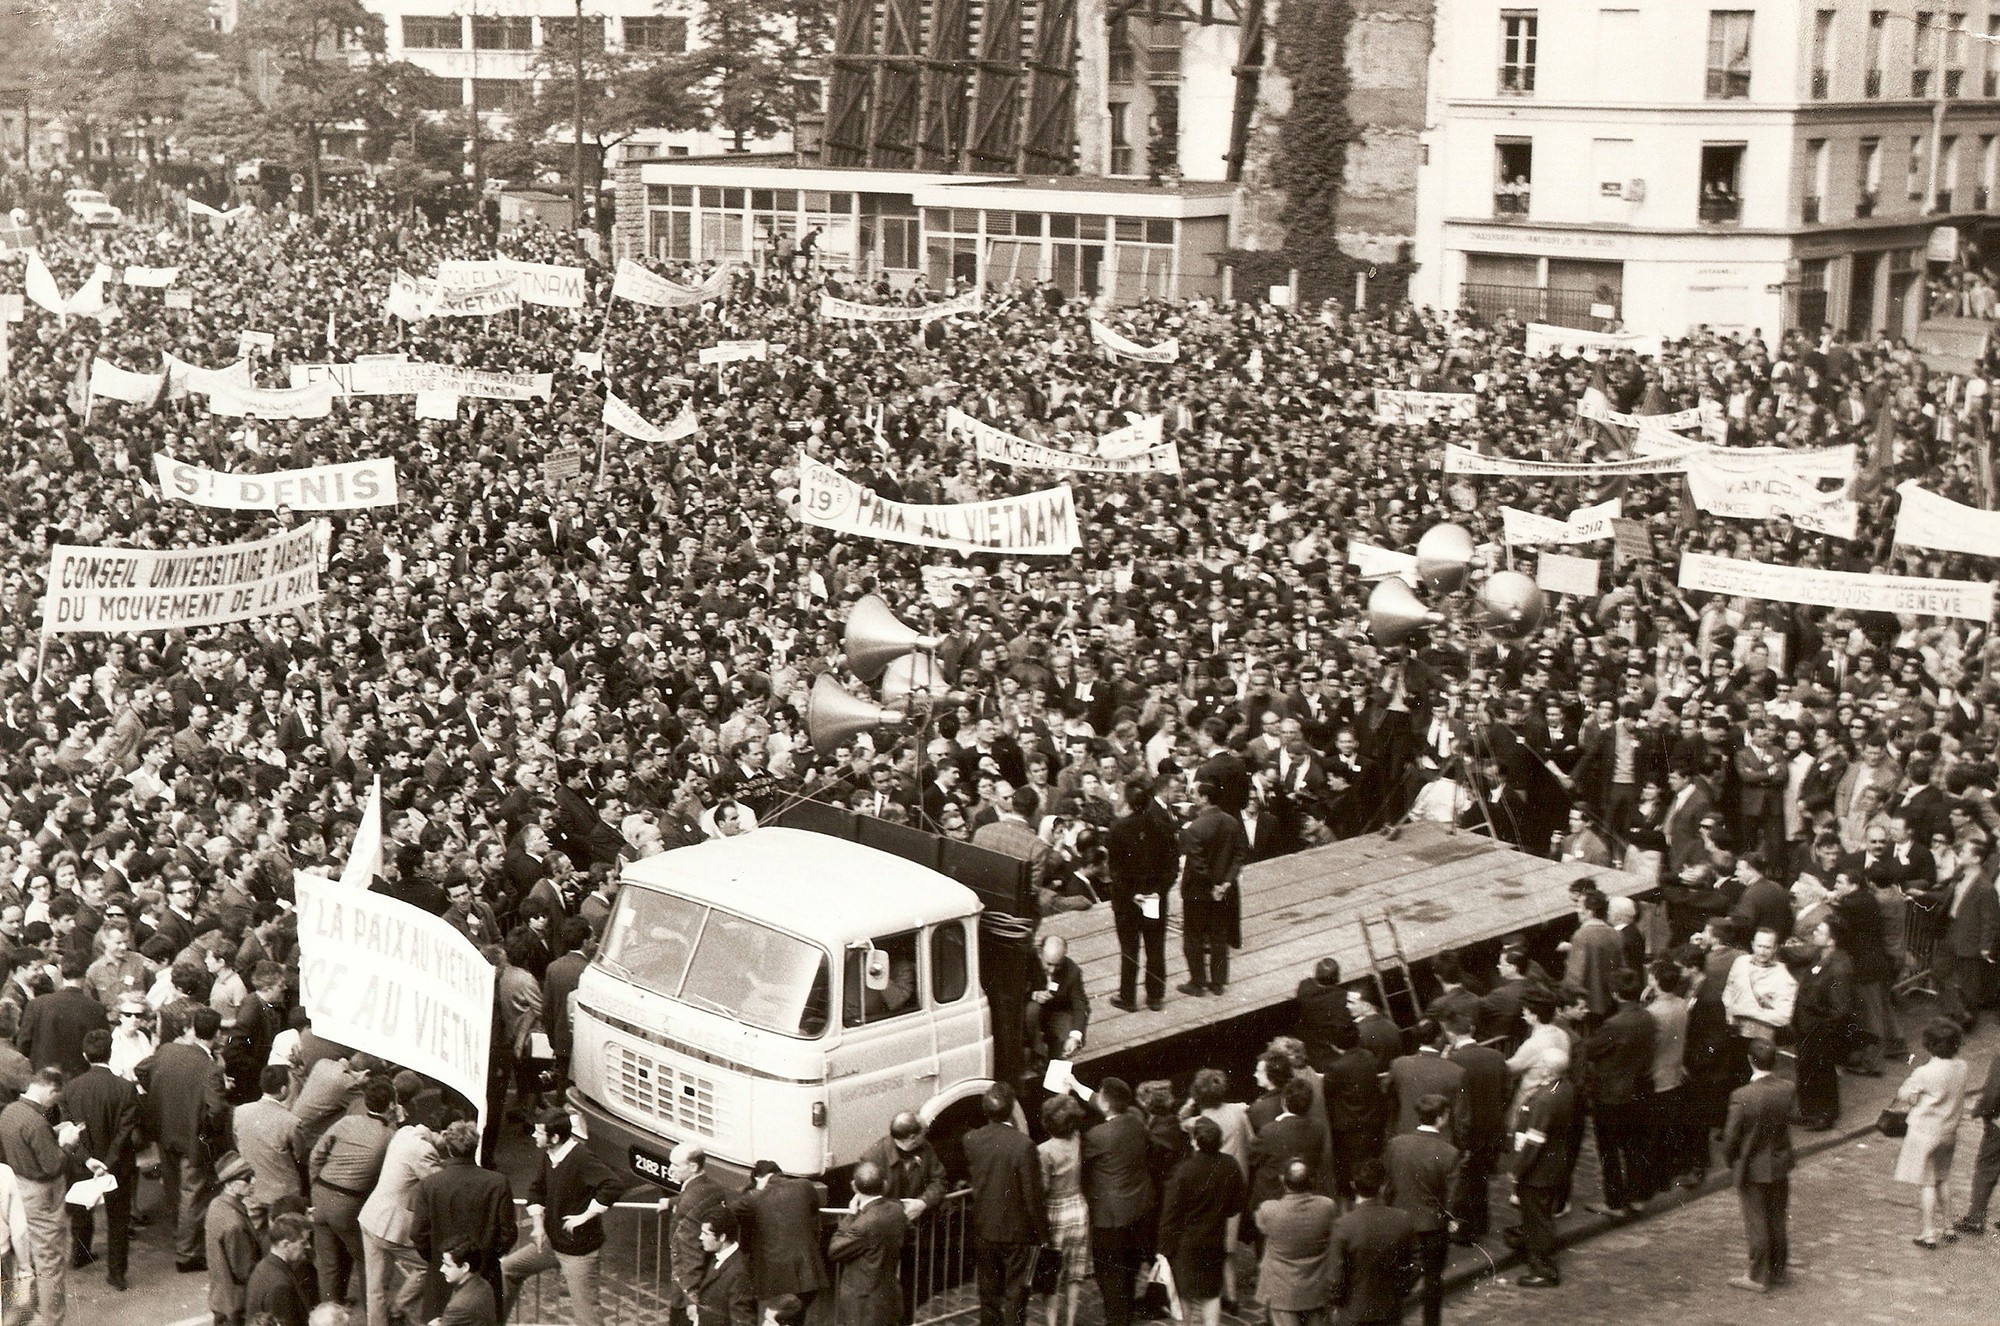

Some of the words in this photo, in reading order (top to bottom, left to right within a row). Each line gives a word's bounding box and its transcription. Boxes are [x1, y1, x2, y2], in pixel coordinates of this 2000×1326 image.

[983, 430, 1043, 465] CONSEIL
[239, 468, 380, 505] DENIS
[920, 511, 950, 539] AU
[963, 495, 1068, 548] VIETNAM
[61, 555, 139, 589] CONSEIL
[149, 547, 269, 588] UNIVERSITAIRE
[57, 596, 86, 623] DU
[98, 591, 224, 622] MOUVEMENT
[229, 588, 253, 614] DE
[260, 581, 280, 608] LA
[286, 570, 315, 601] PAIX
[1894, 592, 1963, 614] GENEVE
[315, 897, 344, 942] LA
[353, 907, 407, 962] PAIX
[410, 925, 431, 973] AU
[350, 974, 403, 1039] AU
[635, 1154, 660, 1177] 2182
